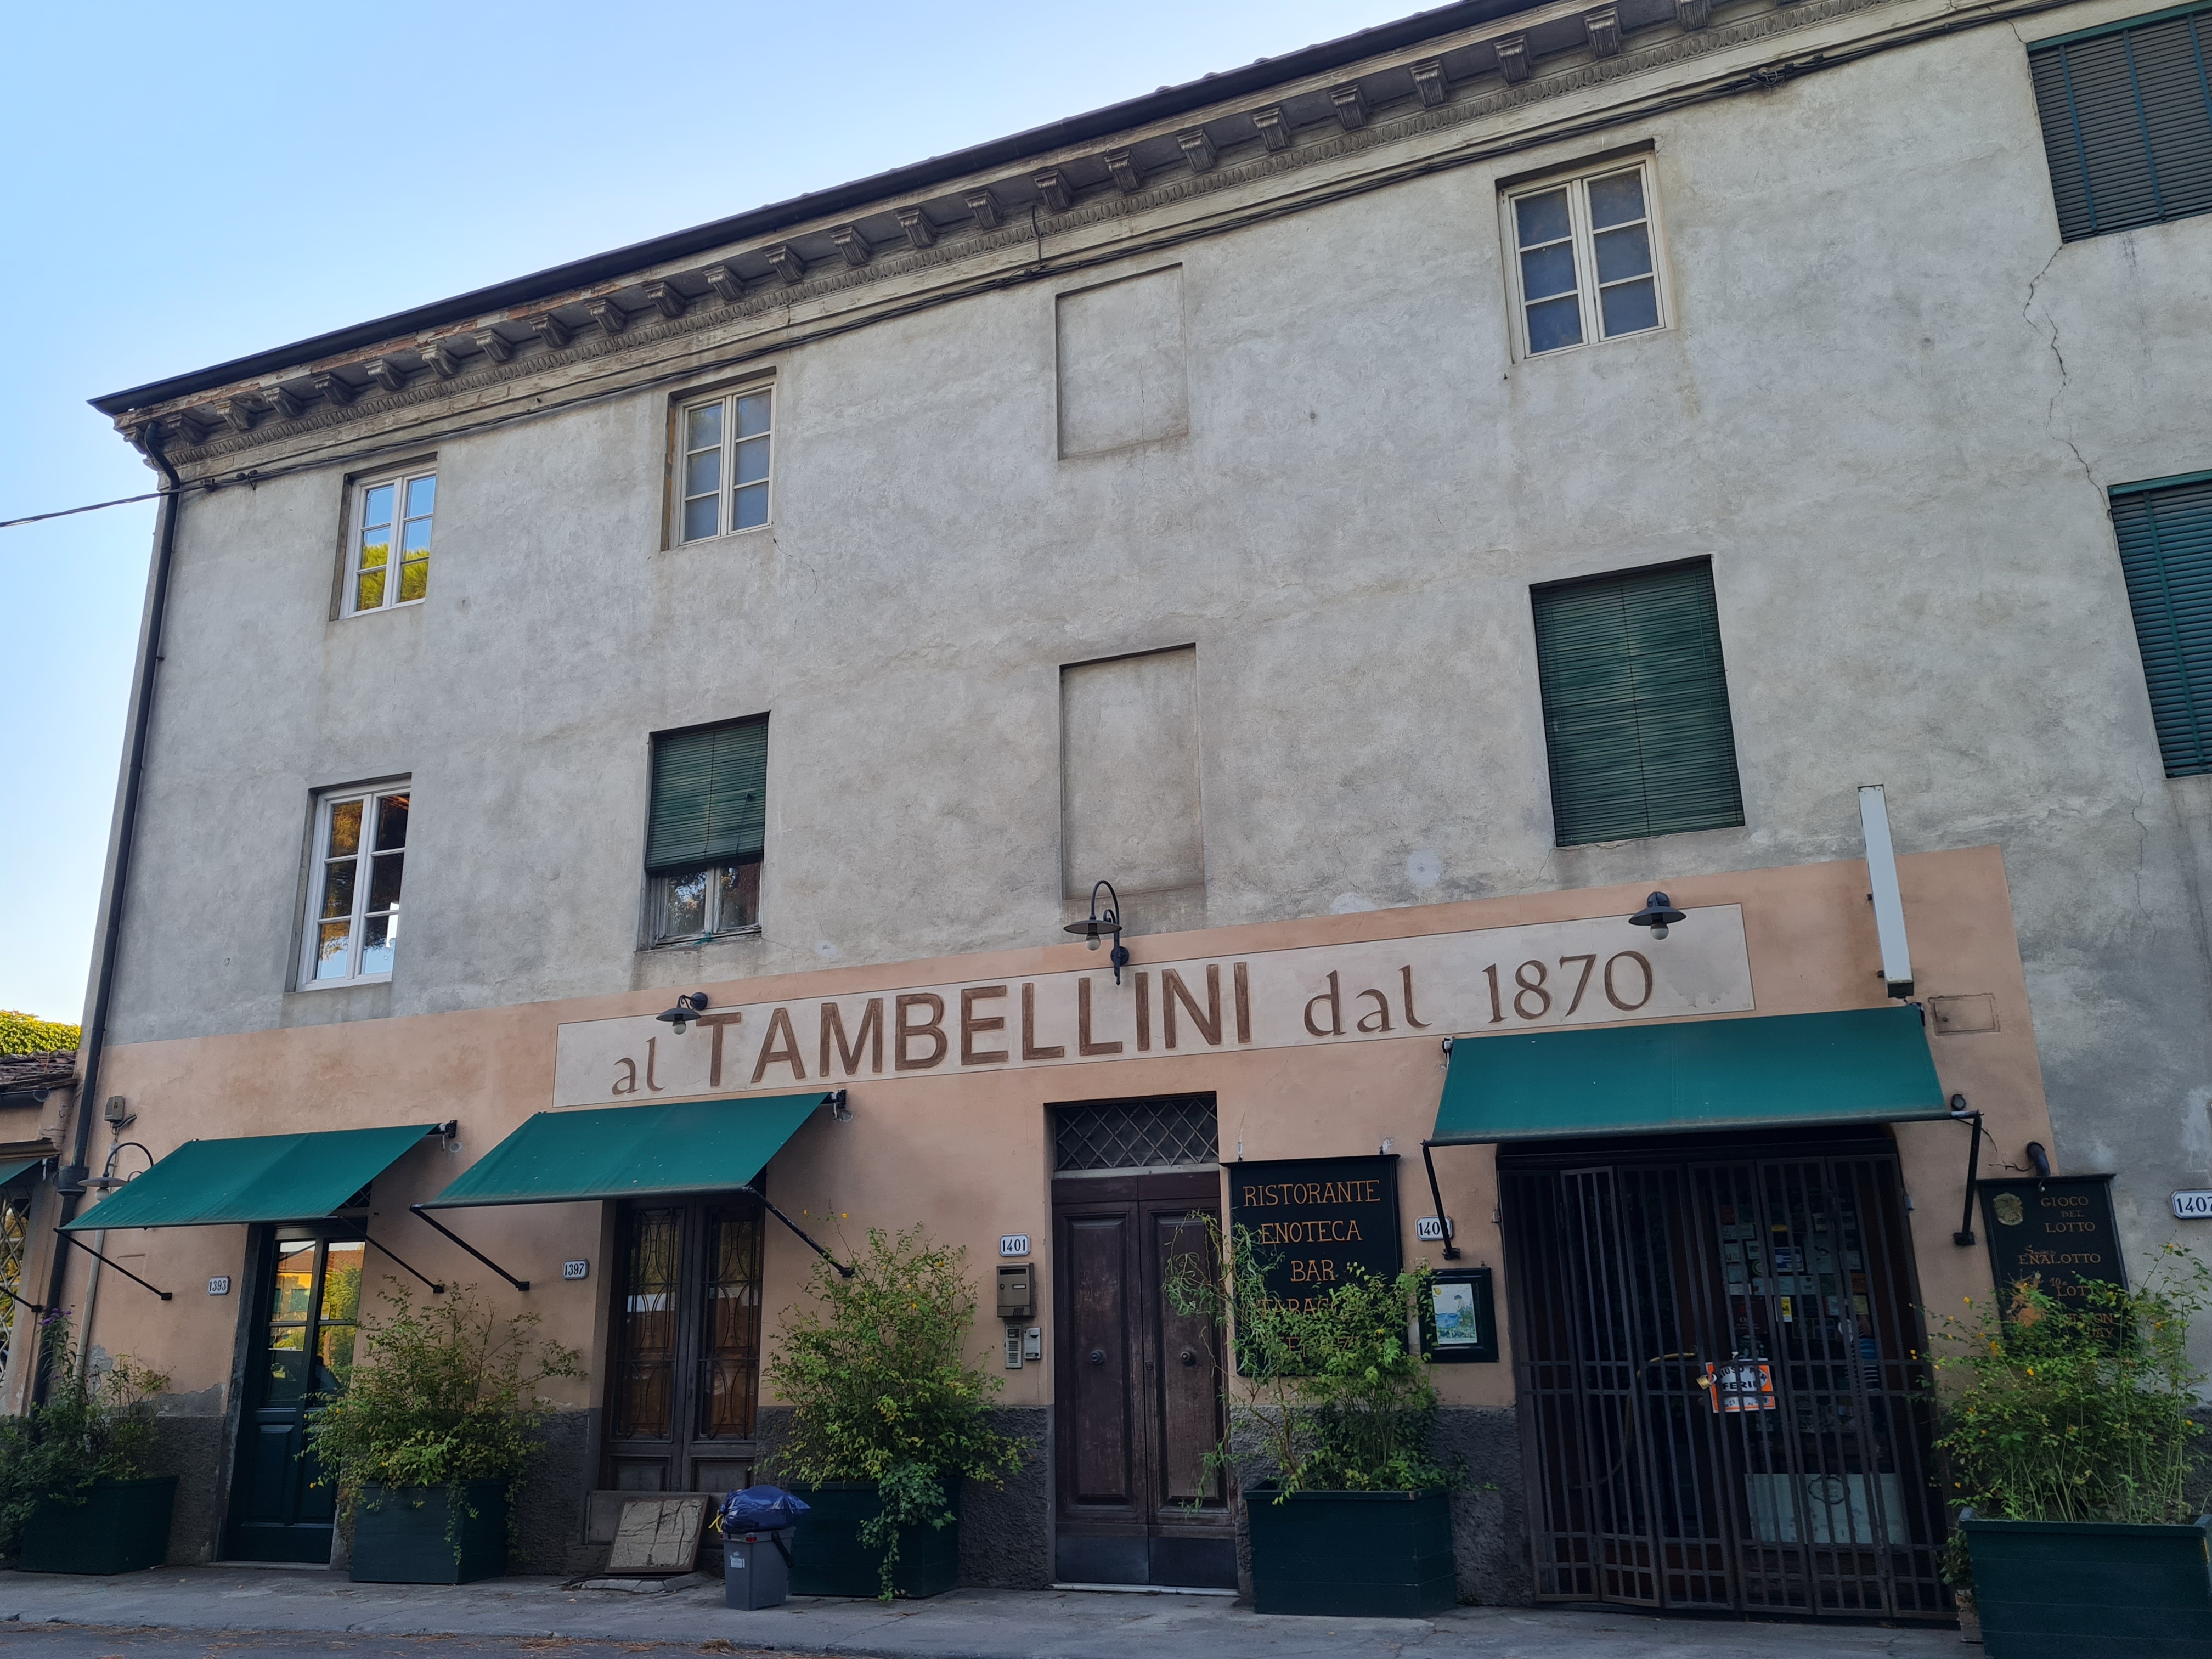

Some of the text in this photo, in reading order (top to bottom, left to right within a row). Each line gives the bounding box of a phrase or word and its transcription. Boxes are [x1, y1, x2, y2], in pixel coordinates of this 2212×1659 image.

[612, 950, 1654, 1095] al TAMBELLINI dal 1870
[1243, 1180, 1380, 1207] RISTORANTE
[2041, 1195, 2089, 1207] GIOCO
[2061, 1210, 2085, 1218] DEL
[1261, 1220, 1363, 1245] ENOTECA
[1419, 1221, 1447, 1235] 140
[2045, 1221, 2096, 1233] LOTTO
[1002, 1239, 1026, 1252] 1401
[2018, 1253, 2101, 1265] ENALOTTO
[565, 1263, 585, 1276] 1397
[1290, 1260, 1336, 1282] BAR
[209, 1280, 227, 1291] 1393
[1722, 1381, 1758, 1390] FERI
